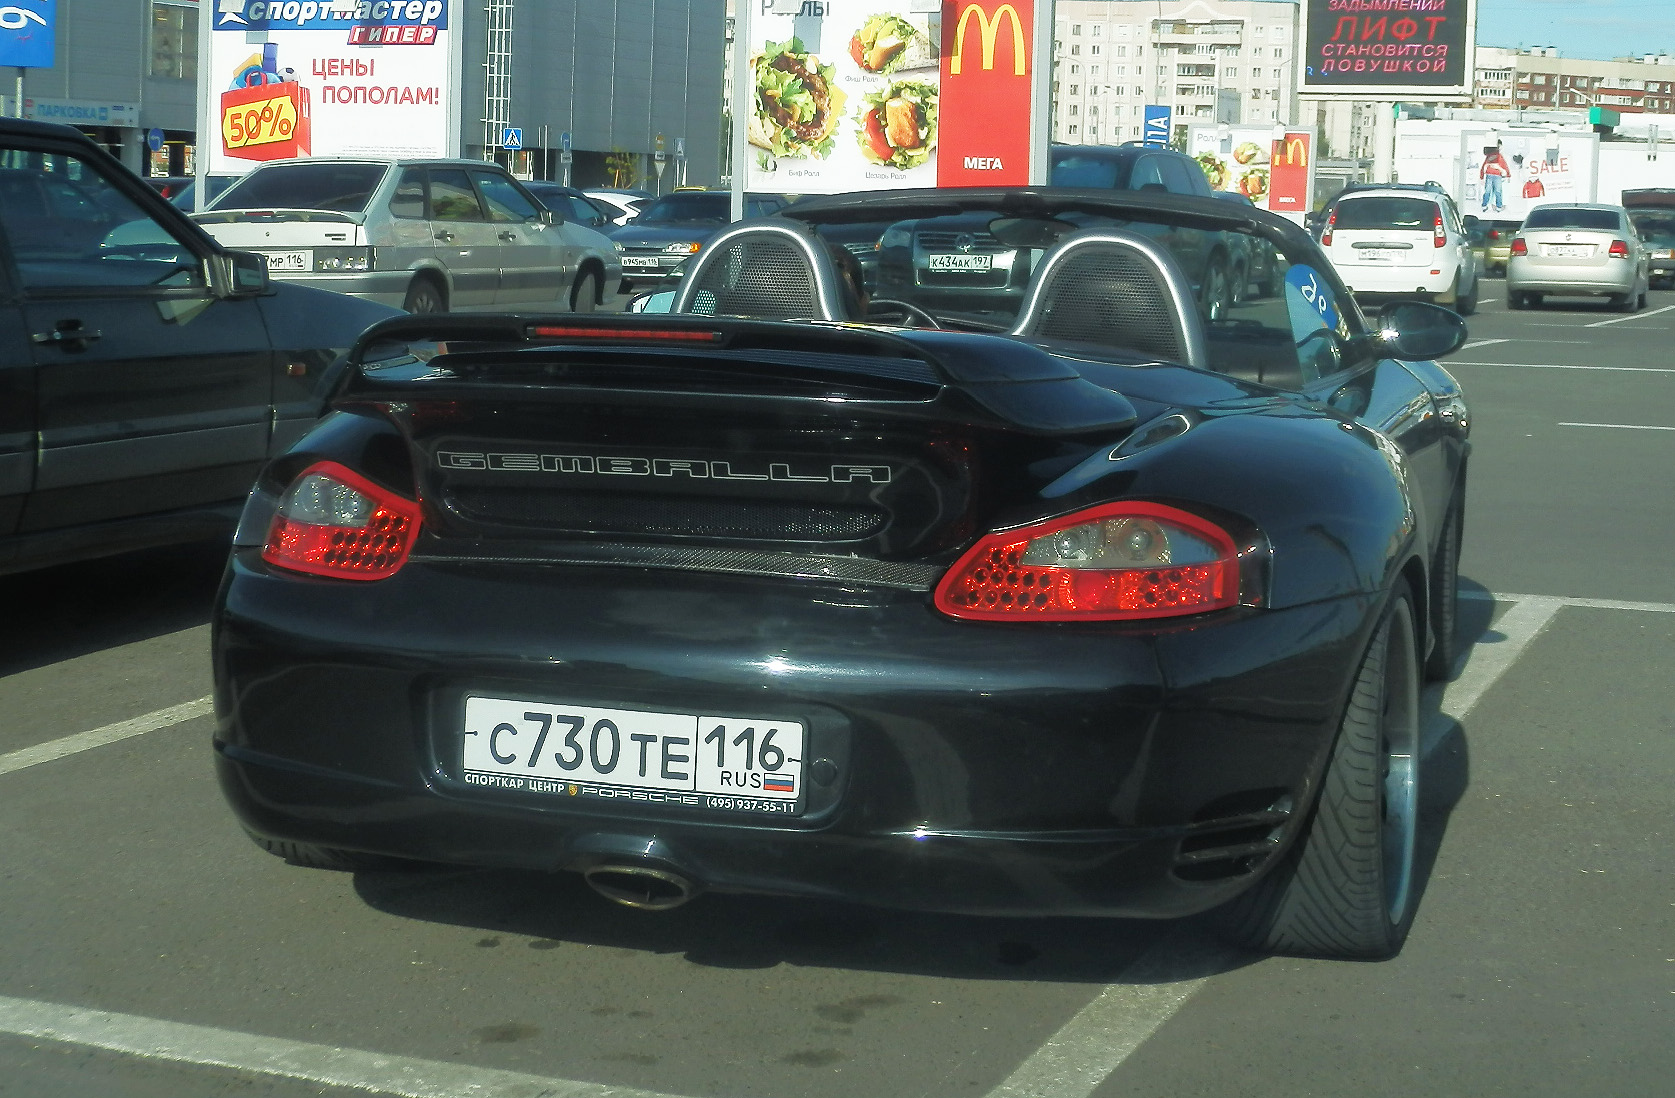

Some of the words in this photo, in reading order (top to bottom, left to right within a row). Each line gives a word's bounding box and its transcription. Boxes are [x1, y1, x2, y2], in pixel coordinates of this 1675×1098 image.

[248, 0, 443, 25] спортастер
[351, 27, 436, 42] ГИПЕР
[1329, 16, 1447, 41] ЛИФТ
[1321, 44, 1448, 57] СТАНОВИТСЯ
[312, 58, 375, 80] ЦЕНЫ
[1321, 58, 1447, 73] ЛОВУШКОЙ
[322, 86, 439, 105] ПОПОЛАМ!
[37, 104, 98, 119] ПАРКОВКА
[229, 104, 292, 142] 50%
[964, 156, 1003, 170] МЕГА
[1529, 157, 1569, 175] SALE
[287, 254, 302, 264] 116
[973, 256, 988, 265] 197
[437, 450, 891, 483] GEMBALLA
[489, 711, 690, 780] С730ТЕ
[704, 724, 785, 771] 116
[720, 771, 762, 789] RUS
[464, 773, 524, 789] СПОРТКАР
[528, 779, 565, 793] ЦЕНТР
[582, 786, 699, 805] PORSCHE
[706, 796, 735, 810] (495)
[736, 799, 795, 813] 937-55-11
